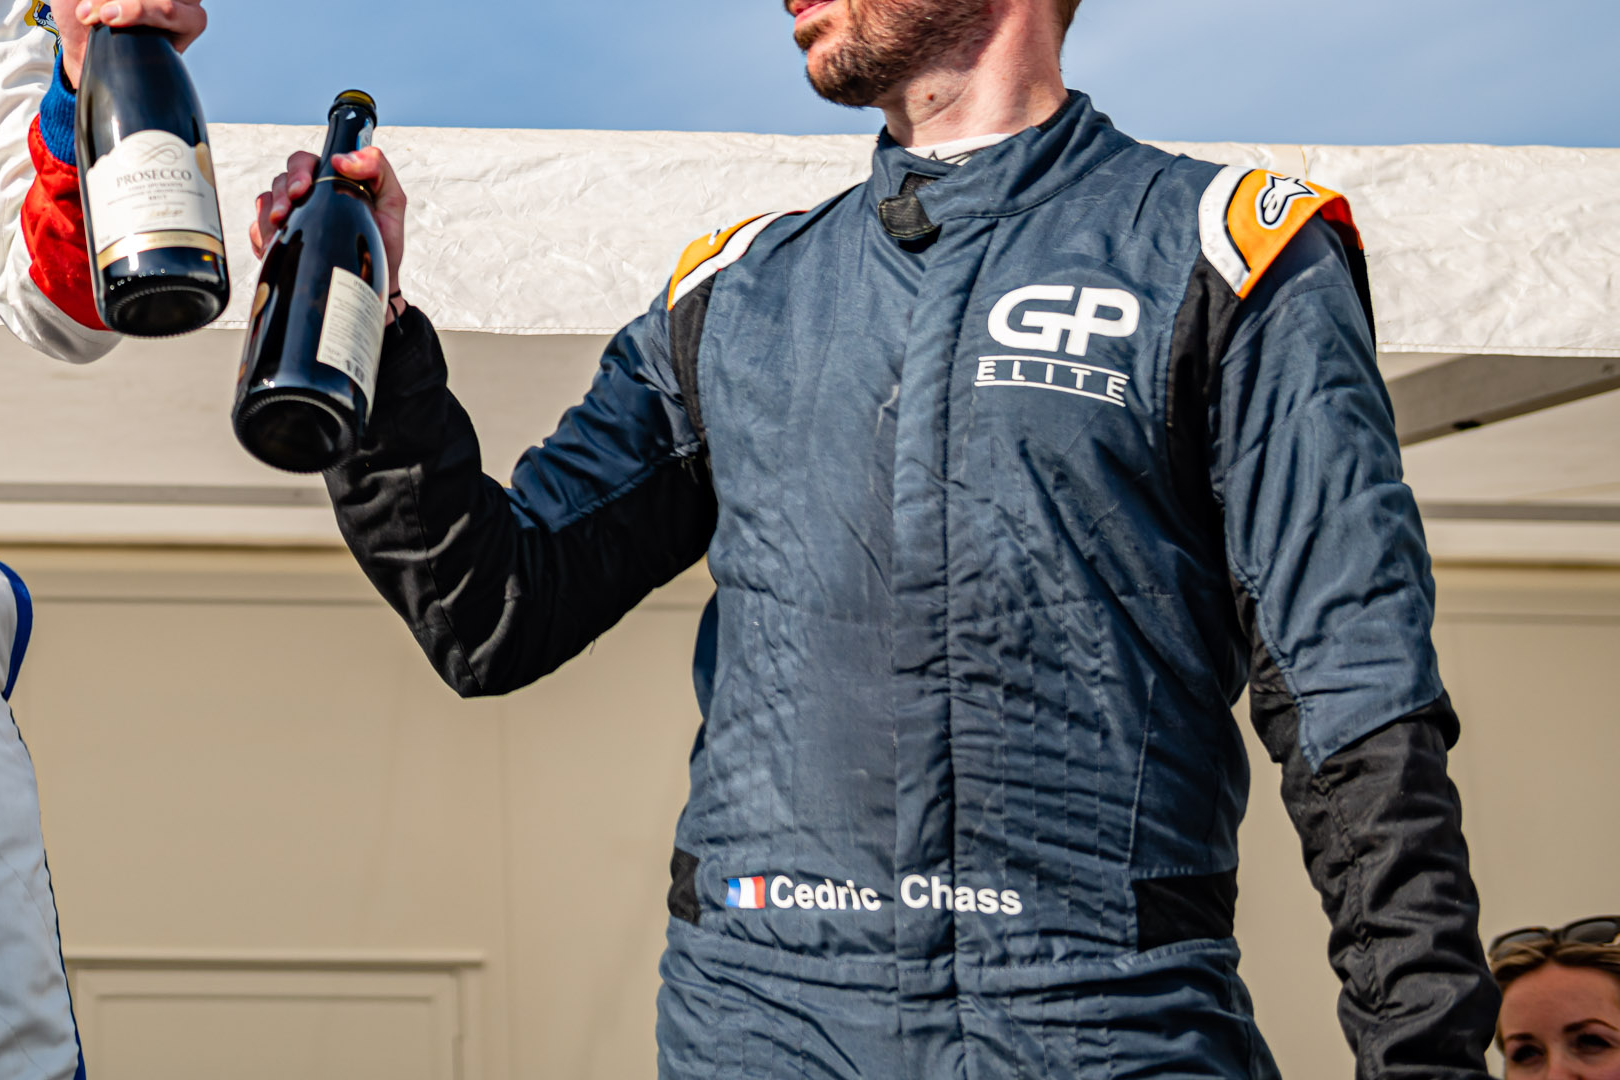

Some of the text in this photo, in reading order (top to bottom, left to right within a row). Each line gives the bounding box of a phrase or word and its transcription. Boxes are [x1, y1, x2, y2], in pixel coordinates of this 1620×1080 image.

[116, 168, 193, 188] PROSECCO
[987, 284, 1141, 357] GP
[976, 361, 1128, 400] ELITE
[770, 874, 1023, 915] Cedric Chass
